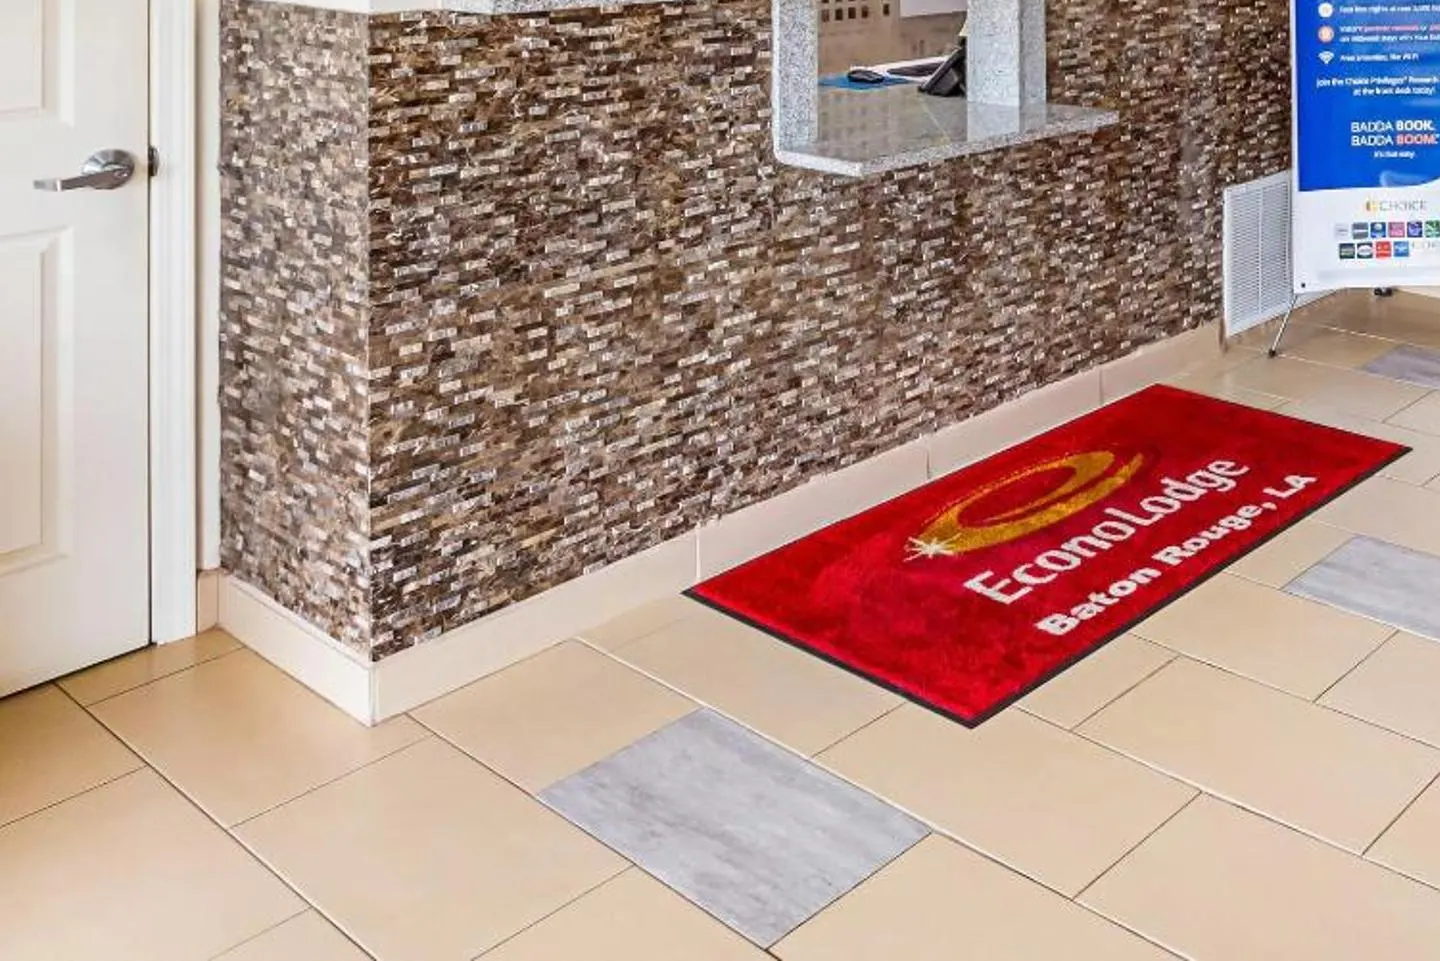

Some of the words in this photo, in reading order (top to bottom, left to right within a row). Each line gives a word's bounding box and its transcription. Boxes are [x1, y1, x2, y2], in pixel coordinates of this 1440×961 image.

[1350, 121, 1393, 133] BADDA
[1350, 135, 1394, 147] BADDA
[963, 458, 1251, 606] EconoLodge
[1035, 564, 1163, 637] Baton
[1153, 498, 1278, 567] Rouge,
[1262, 472, 1320, 499] LA
